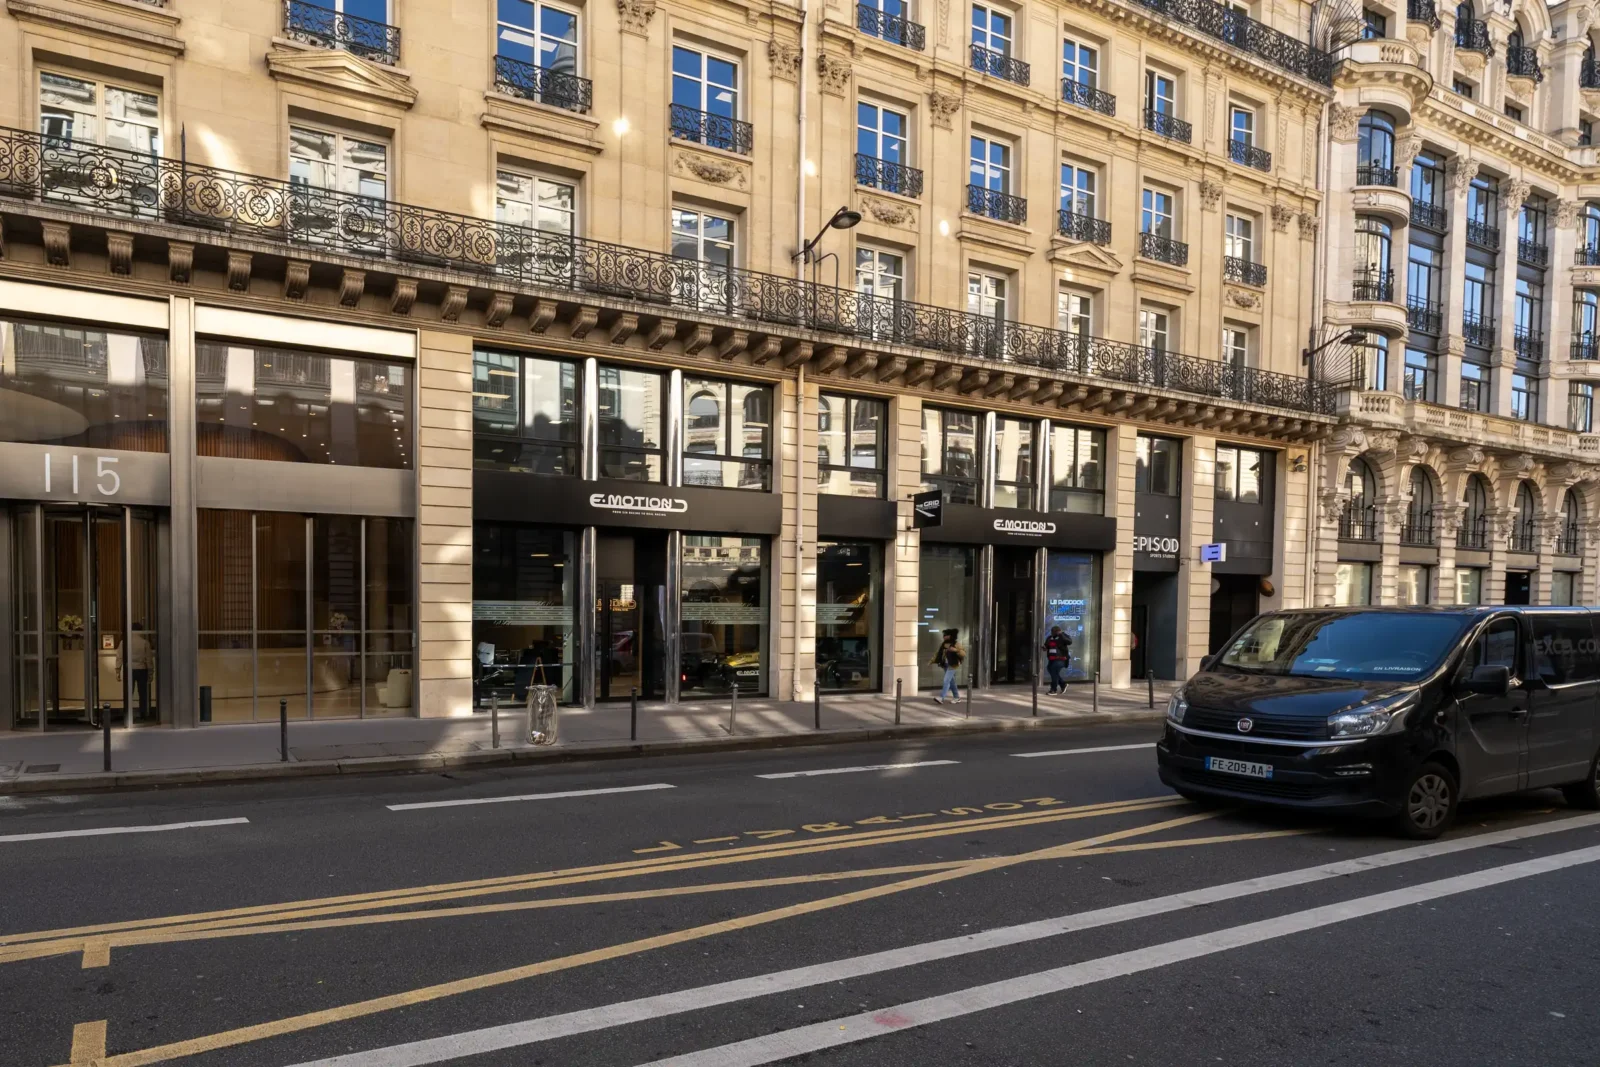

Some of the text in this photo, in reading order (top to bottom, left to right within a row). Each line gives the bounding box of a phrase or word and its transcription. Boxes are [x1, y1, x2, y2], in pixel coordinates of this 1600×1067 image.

[45, 453, 120, 496] 115
[1133, 536, 1179, 553] EPISOD
[1211, 760, 1264, 776] FE-209-AA
[632, 797, 1066, 854] LIVRAISON
